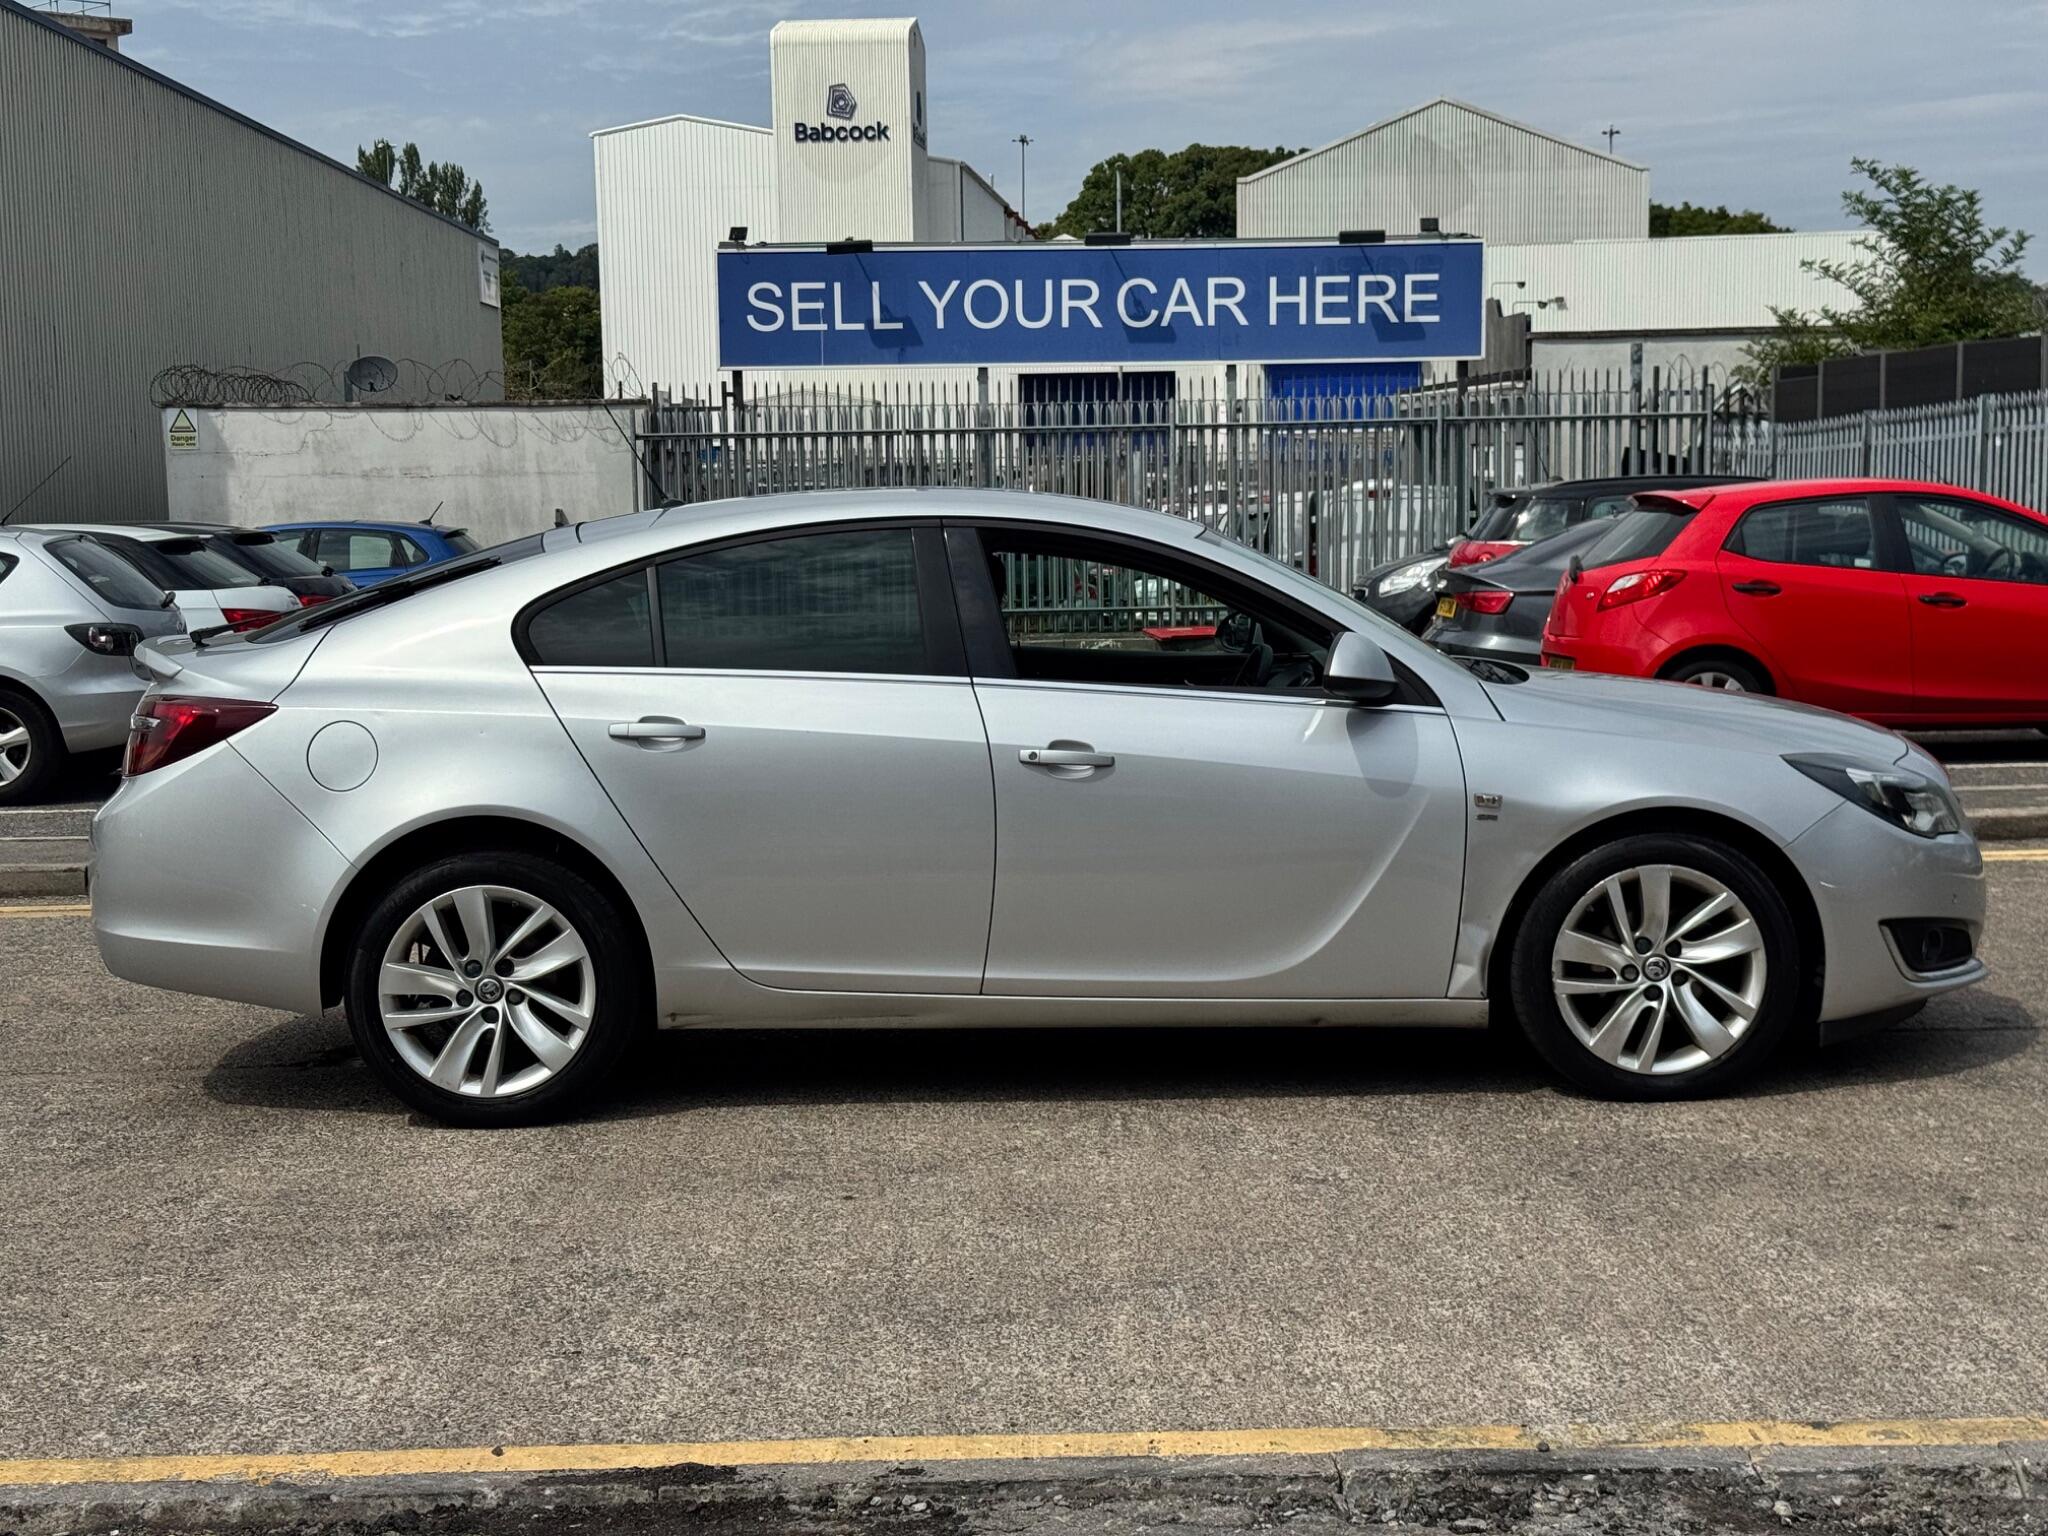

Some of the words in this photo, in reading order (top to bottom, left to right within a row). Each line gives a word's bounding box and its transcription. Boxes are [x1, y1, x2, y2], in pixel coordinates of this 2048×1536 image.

[794, 121, 890, 143] Babcock
[746, 281, 904, 332] SELL
[918, 279, 1103, 330] YOUR
[1116, 277, 1249, 328] CAR
[1269, 273, 1441, 326] HERE
